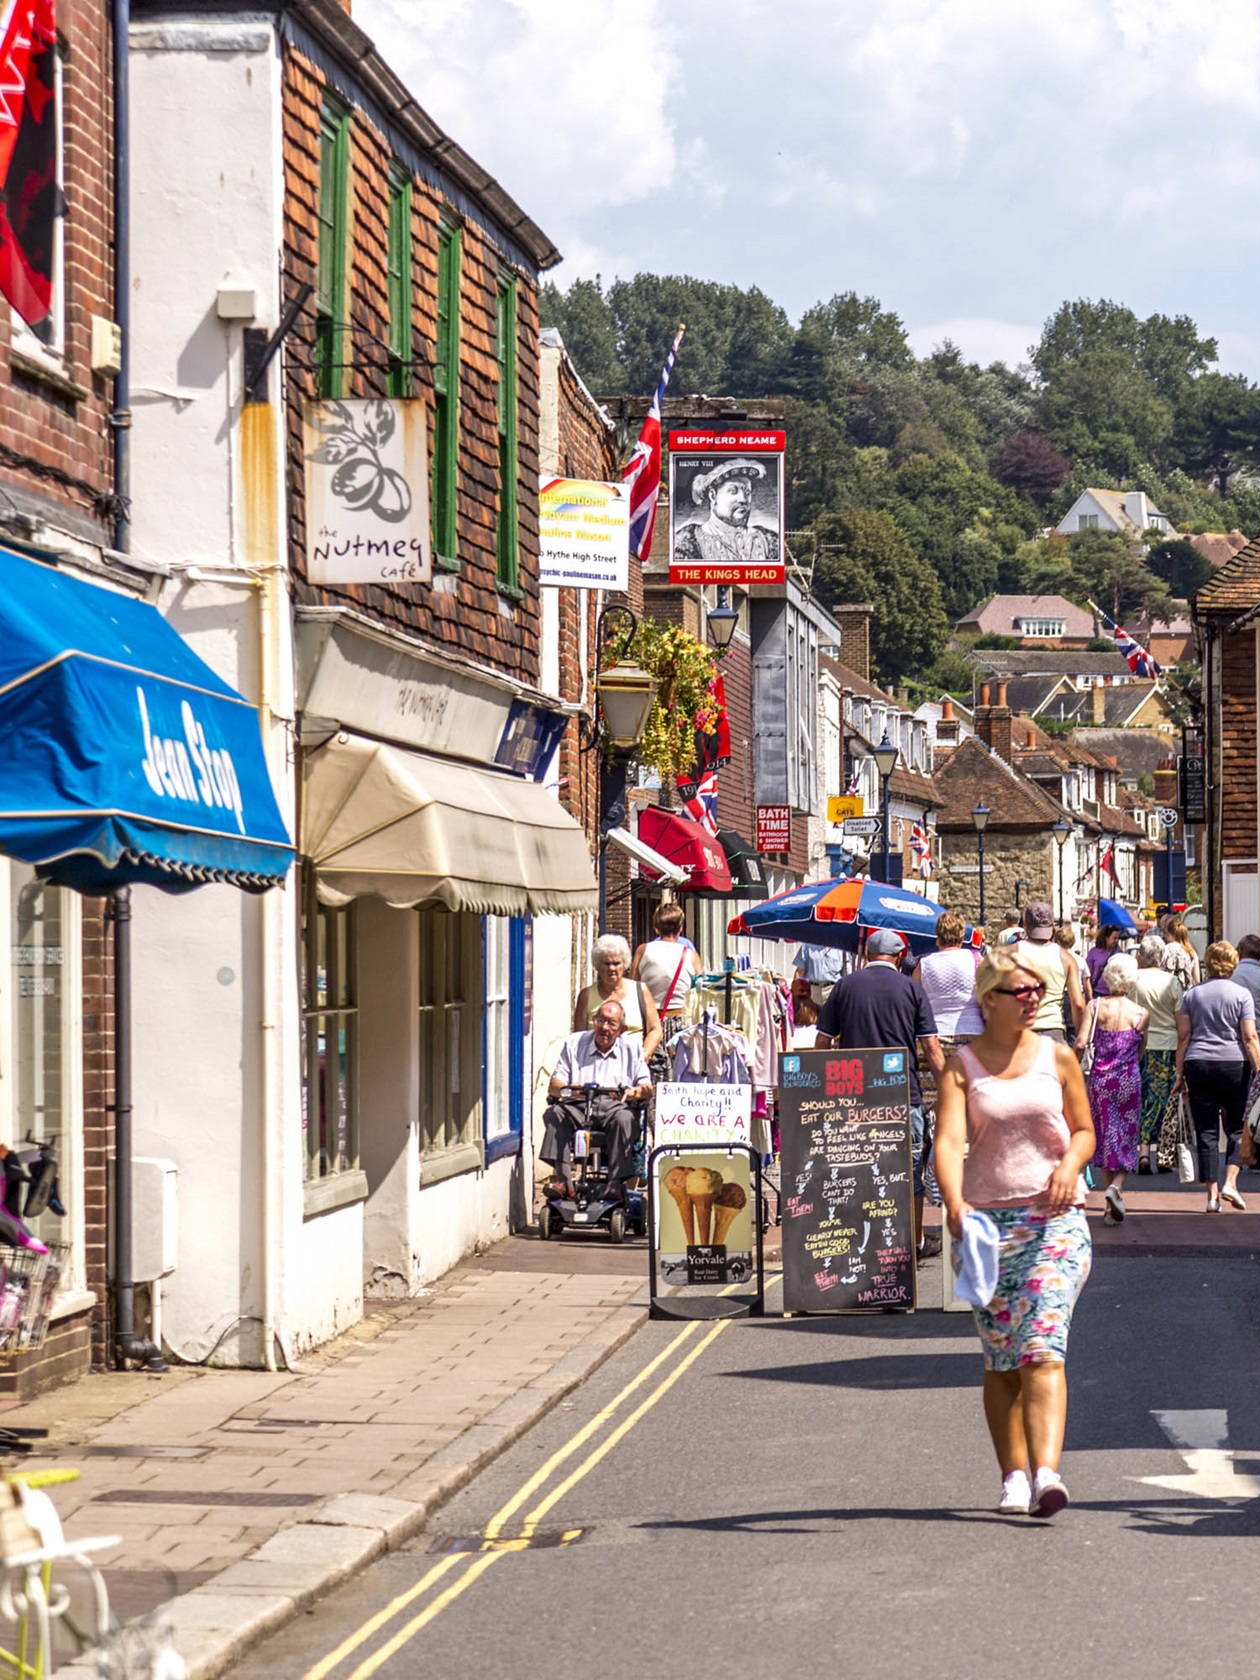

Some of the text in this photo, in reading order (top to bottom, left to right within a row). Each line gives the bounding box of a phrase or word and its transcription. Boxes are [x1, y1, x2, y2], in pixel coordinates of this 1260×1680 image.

[676, 436, 777, 445] SHEPHERD NEAME
[318, 525, 338, 538] the
[540, 527, 572, 538] auline
[547, 549, 571, 561] Hythe
[573, 552, 591, 563] High
[593, 553, 617, 564] Street
[678, 569, 777, 580] THE KINGS HEAD
[136, 685, 247, 836] Jean Stop
[758, 808, 789, 819] BATH
[758, 820, 789, 831] TIME
[825, 1059, 864, 1081] BIG
[693, 1086, 716, 1097] hope
[719, 1087, 742, 1096] and
[825, 1081, 864, 1096] BOYS
[799, 1100, 836, 1112] SHOULD
[801, 1105, 908, 1125] EAT OUR BURGERS?
[734, 1116, 745, 1128] A
[660, 1128, 735, 1143] CHARITY
[811, 1130, 823, 1139] DO
[813, 1137, 825, 1145] TO
[827, 1135, 846, 1144] FEEL
[849, 1132, 867, 1141] LIKE
[809, 1143, 898, 1155] ARE DANCING ON YOUR
[825, 1152, 881, 1163] TASTEBUDS?
[822, 1177, 858, 1189] BURGERS
[843, 1188, 855, 1196] DO
[787, 1196, 801, 1207] EAT
[827, 1197, 849, 1206] THAT!
[862, 1199, 895, 1209] ARE YOU
[786, 1203, 814, 1215] THEM!
[868, 1208, 898, 1218] AFRAID?
[806, 1228, 858, 1241] CLEARLY NEVER
[881, 1228, 897, 1237] YES
[804, 1241, 828, 1251] EATEN
[874, 1246, 908, 1257] THEY WILL
[688, 1255, 725, 1265] Yorvale
[877, 1254, 911, 1265] TURN YOU
[814, 1269, 829, 1279] EAT
[849, 1264, 867, 1274] NOT!
[871, 1274, 897, 1285] TRUE
